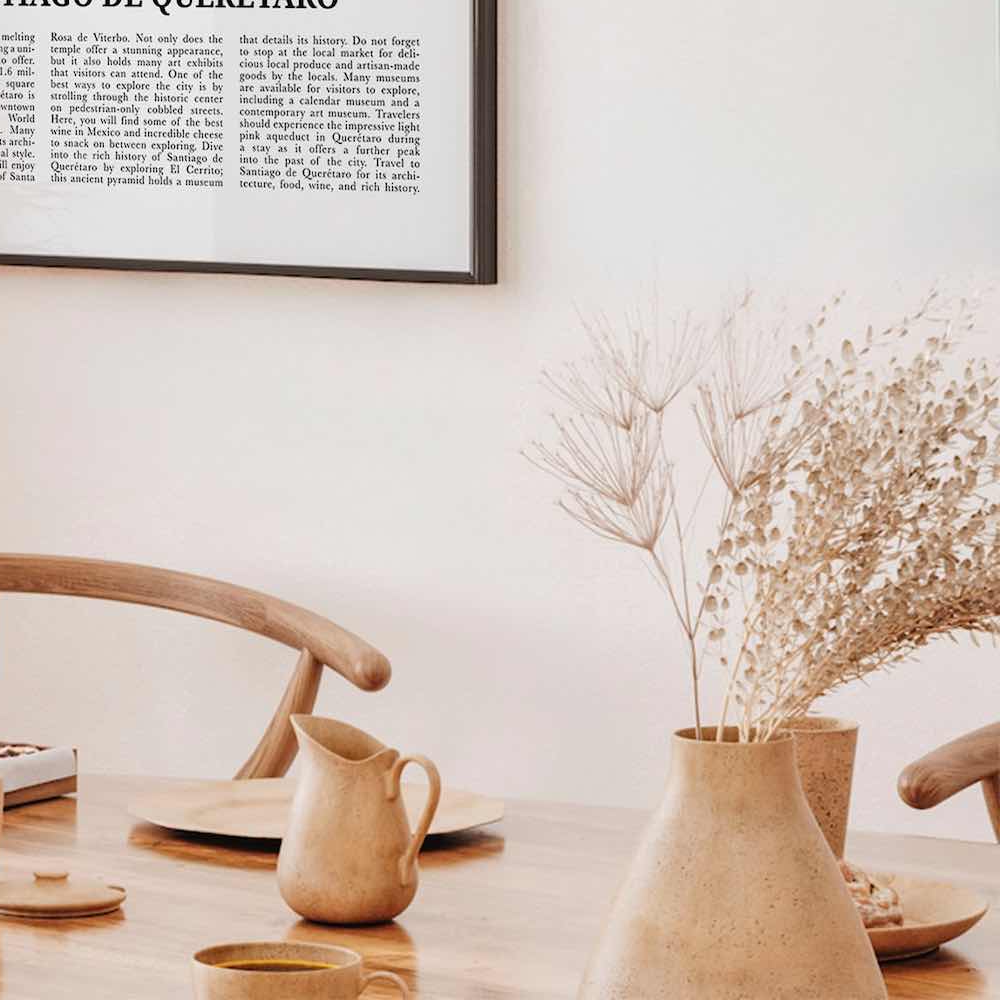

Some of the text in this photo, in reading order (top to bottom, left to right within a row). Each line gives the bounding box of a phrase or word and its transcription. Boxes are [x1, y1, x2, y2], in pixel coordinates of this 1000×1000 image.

[2, 32, 35, 43] melting
[51, 33, 223, 45] Rosa de Viterbo. Not only does the
[239, 36, 420, 48] that details its history. Do not forget
[50, 44, 81, 56] temple
[86, 45, 107, 54] offer
[122, 45, 162, 57] stunning
[167, 48, 223, 58] appearance,
[12, 55, 34, 64] offer.
[0, 66, 12, 76] 1.6
[17, 67, 34, 76] mil-
[239, 60, 420, 72] cious local produce and artisan-made
[50, 68, 68, 77] that
[73, 68, 106, 78] visitors
[131, 69, 163, 79] attend.
[168, 70, 188, 79] One
[193, 70, 203, 79] of
[208, 70, 224, 79] the
[239, 71, 267, 83] goods
[272, 72, 283, 83] by
[288, 72, 303, 81] the
[308, 72, 338, 82] locals.
[343, 73, 371, 84] Many
[260, 84, 302, 93] available
[307, 84, 320, 94] for
[326, 84, 361, 94] visitors
[366, 85, 376, 94] to
[381, 85, 420, 97] explore,
[51, 91, 223, 104] strolling through the historic center
[70, 103, 140, 116] pedestrian-only
[147, 105, 183, 114] cobbled
[190, 106, 223, 115] streets.
[239, 107, 305, 120] contemporary
[310, 108, 323, 118] art
[376, 109, 420, 119] Travelers
[9, 113, 35, 123] World
[239, 119, 420, 133] should experience the impressive light
[50, 127, 223, 139] wine in Mexico and incredible cheese
[239, 131, 420, 145] pink aqueduct in Querétaro during
[9, 137, 35, 146] archi-
[12, 148, 35, 160] style.
[50, 150, 223, 165] into the rich history of Santiago de
[50, 162, 224, 177] Querétaro by exploring El Cerrito;
[240, 167, 420, 180] Santiago de Querétaro for its archi-
[10, 172, 35, 181] Santa
[240, 179, 420, 194] tecture, food, wine, and rich history.
